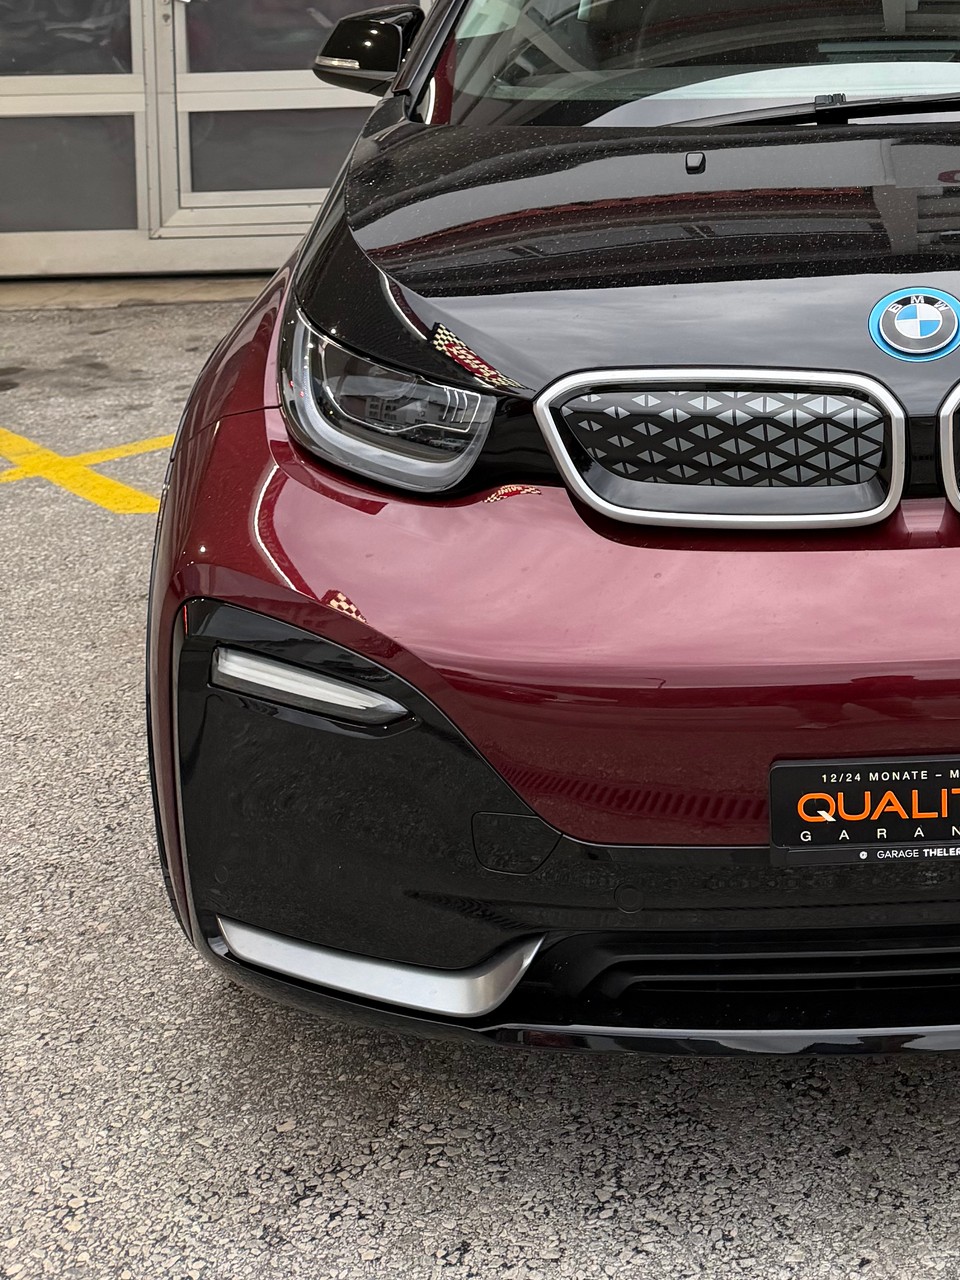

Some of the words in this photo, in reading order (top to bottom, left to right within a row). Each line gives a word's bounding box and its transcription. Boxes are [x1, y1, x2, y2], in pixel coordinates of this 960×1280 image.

[887, 295, 950, 313] BMW
[821, 772, 862, 784] 12/24
[869, 770, 928, 781] MONATE
[876, 848, 919, 859] GARAGE
